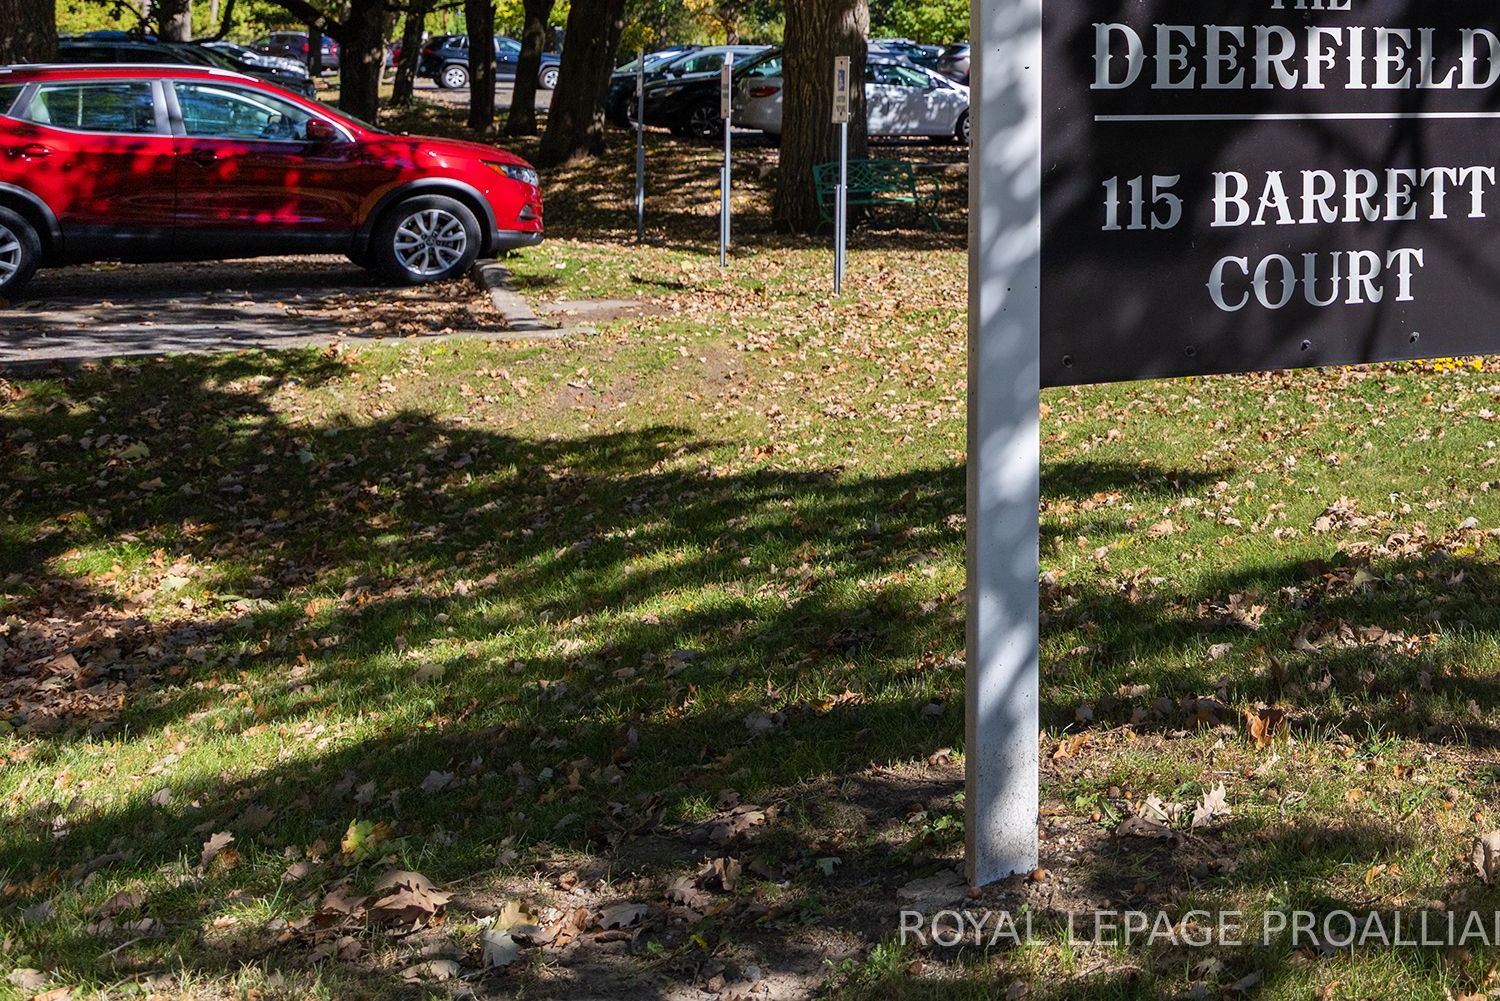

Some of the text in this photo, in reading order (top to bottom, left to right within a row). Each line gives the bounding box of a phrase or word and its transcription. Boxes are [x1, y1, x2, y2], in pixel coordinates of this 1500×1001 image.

[1101, 166, 1496, 231] 115 BARRETT
[1206, 248, 1424, 312] COURT
